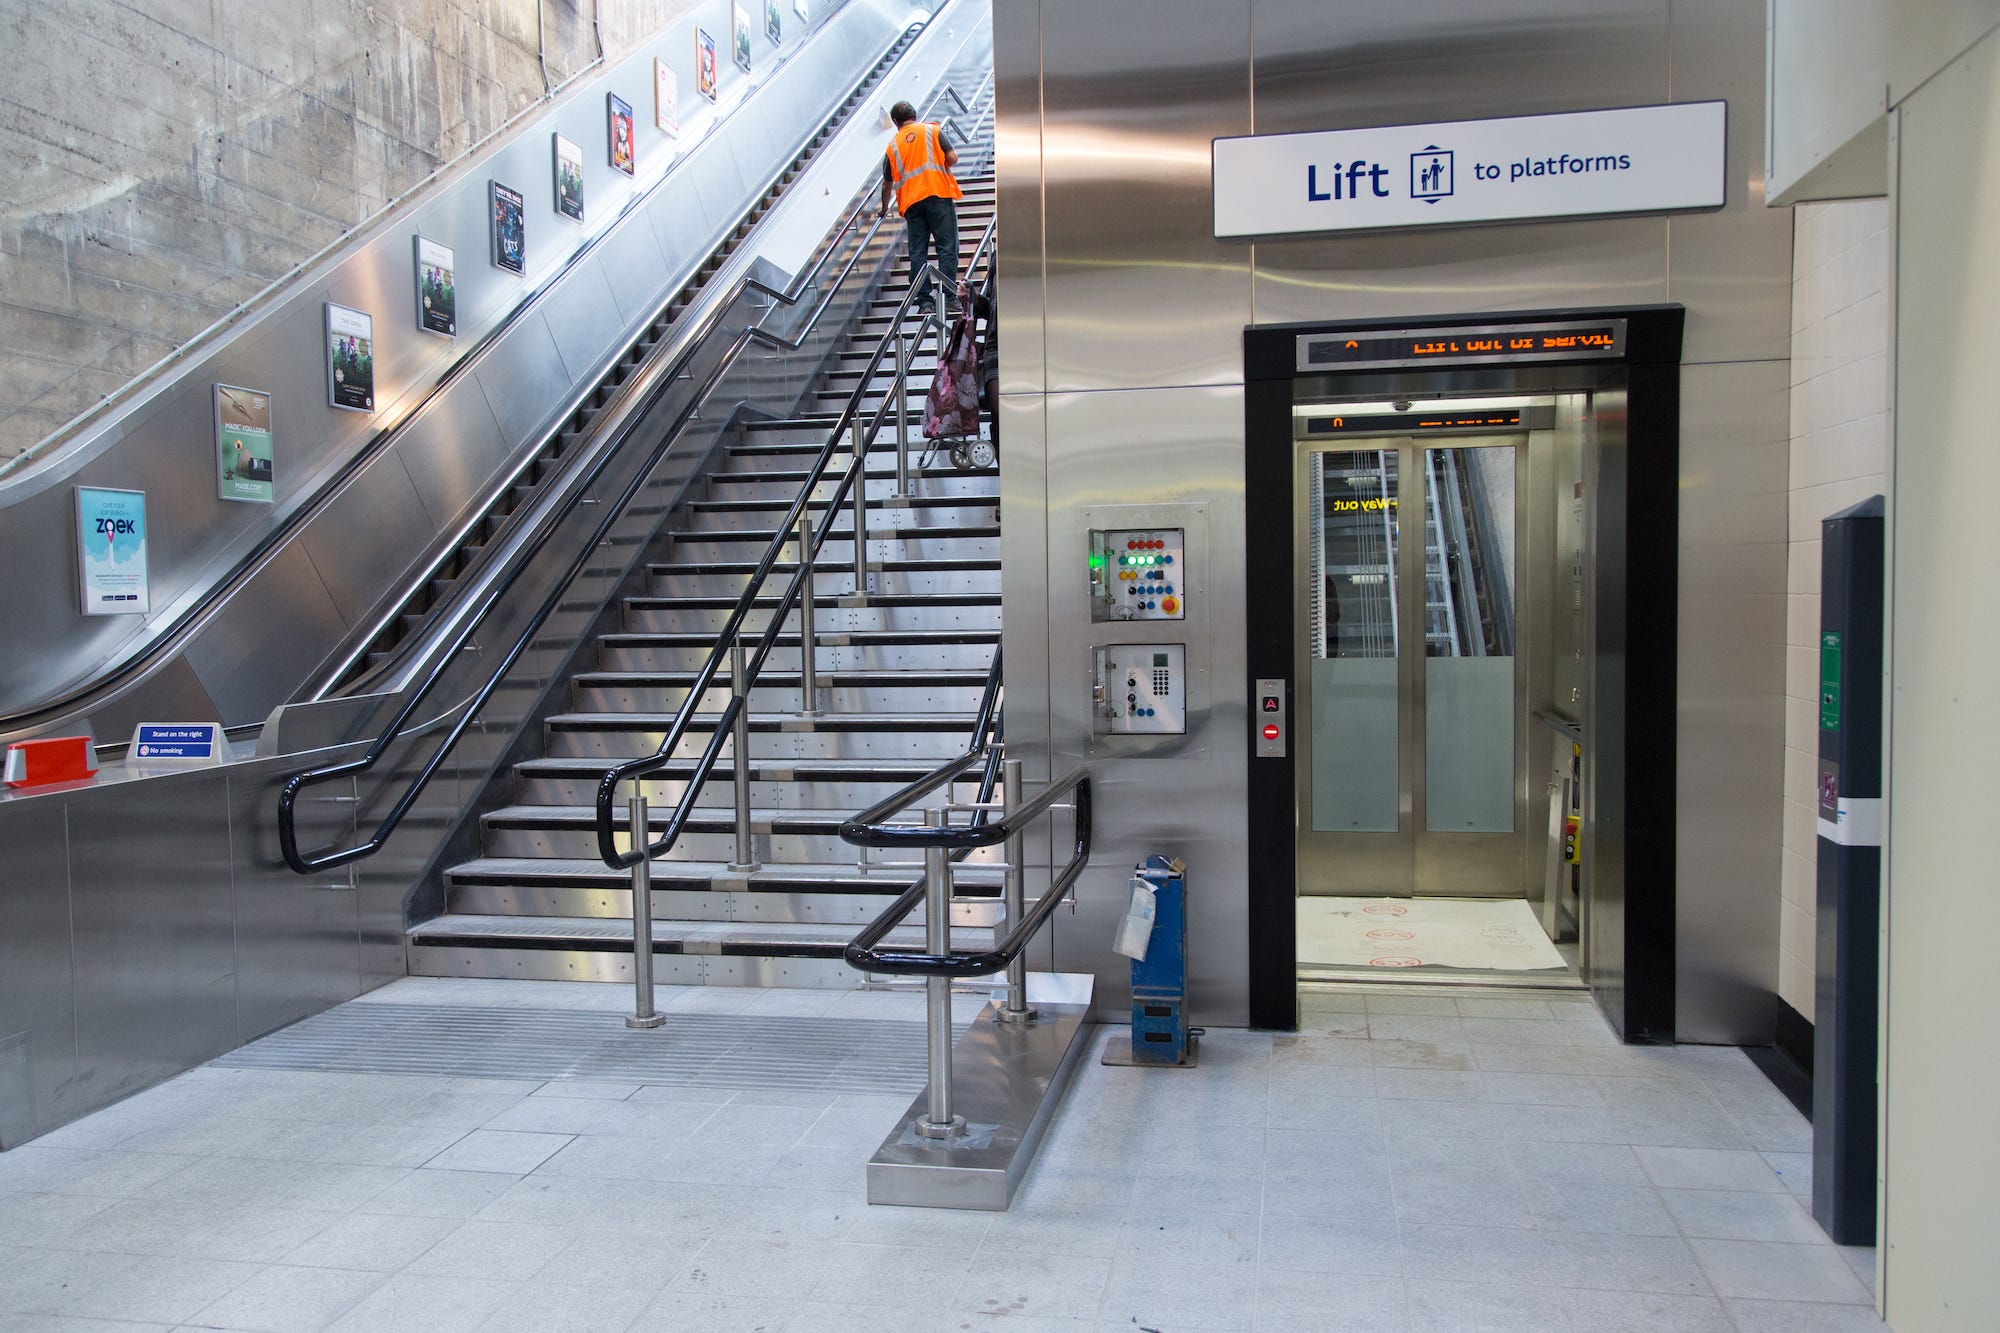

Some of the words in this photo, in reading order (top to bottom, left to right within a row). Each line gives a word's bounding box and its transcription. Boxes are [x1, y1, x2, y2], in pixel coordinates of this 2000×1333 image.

[1308, 160, 1389, 201] Lift
[1474, 162, 1500, 180] to
[1510, 154, 1631, 182] platforms
[152, 730, 169, 738] Stand
[189, 730, 203, 739] right
[160, 747, 183, 755] smoking
